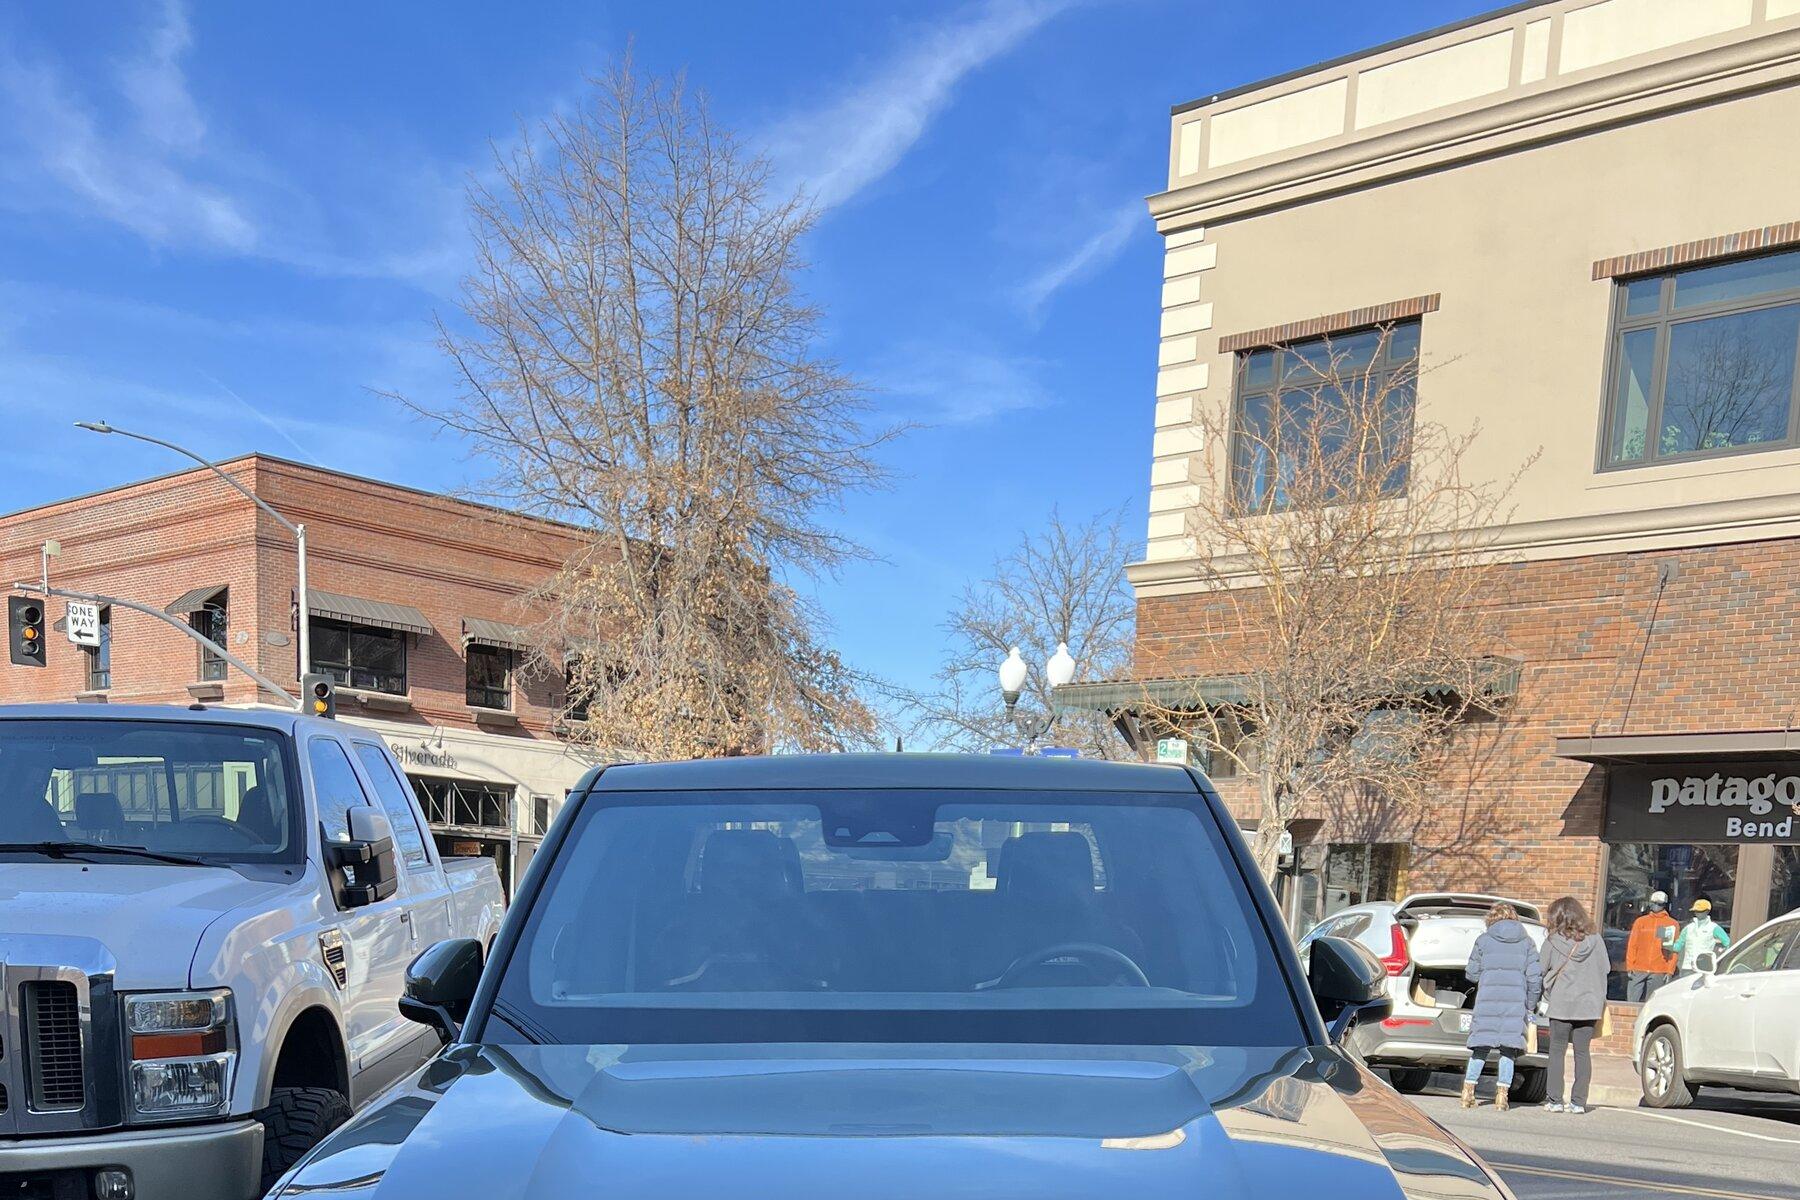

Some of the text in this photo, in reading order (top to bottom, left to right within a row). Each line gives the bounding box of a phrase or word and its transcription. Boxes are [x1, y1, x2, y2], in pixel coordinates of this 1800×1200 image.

[71, 605, 94, 617] ONE
[71, 616, 95, 628] WAY
[391, 743, 456, 769] Silverado
[1649, 773, 1800, 815] patago
[1726, 816, 1793, 838] Bend
